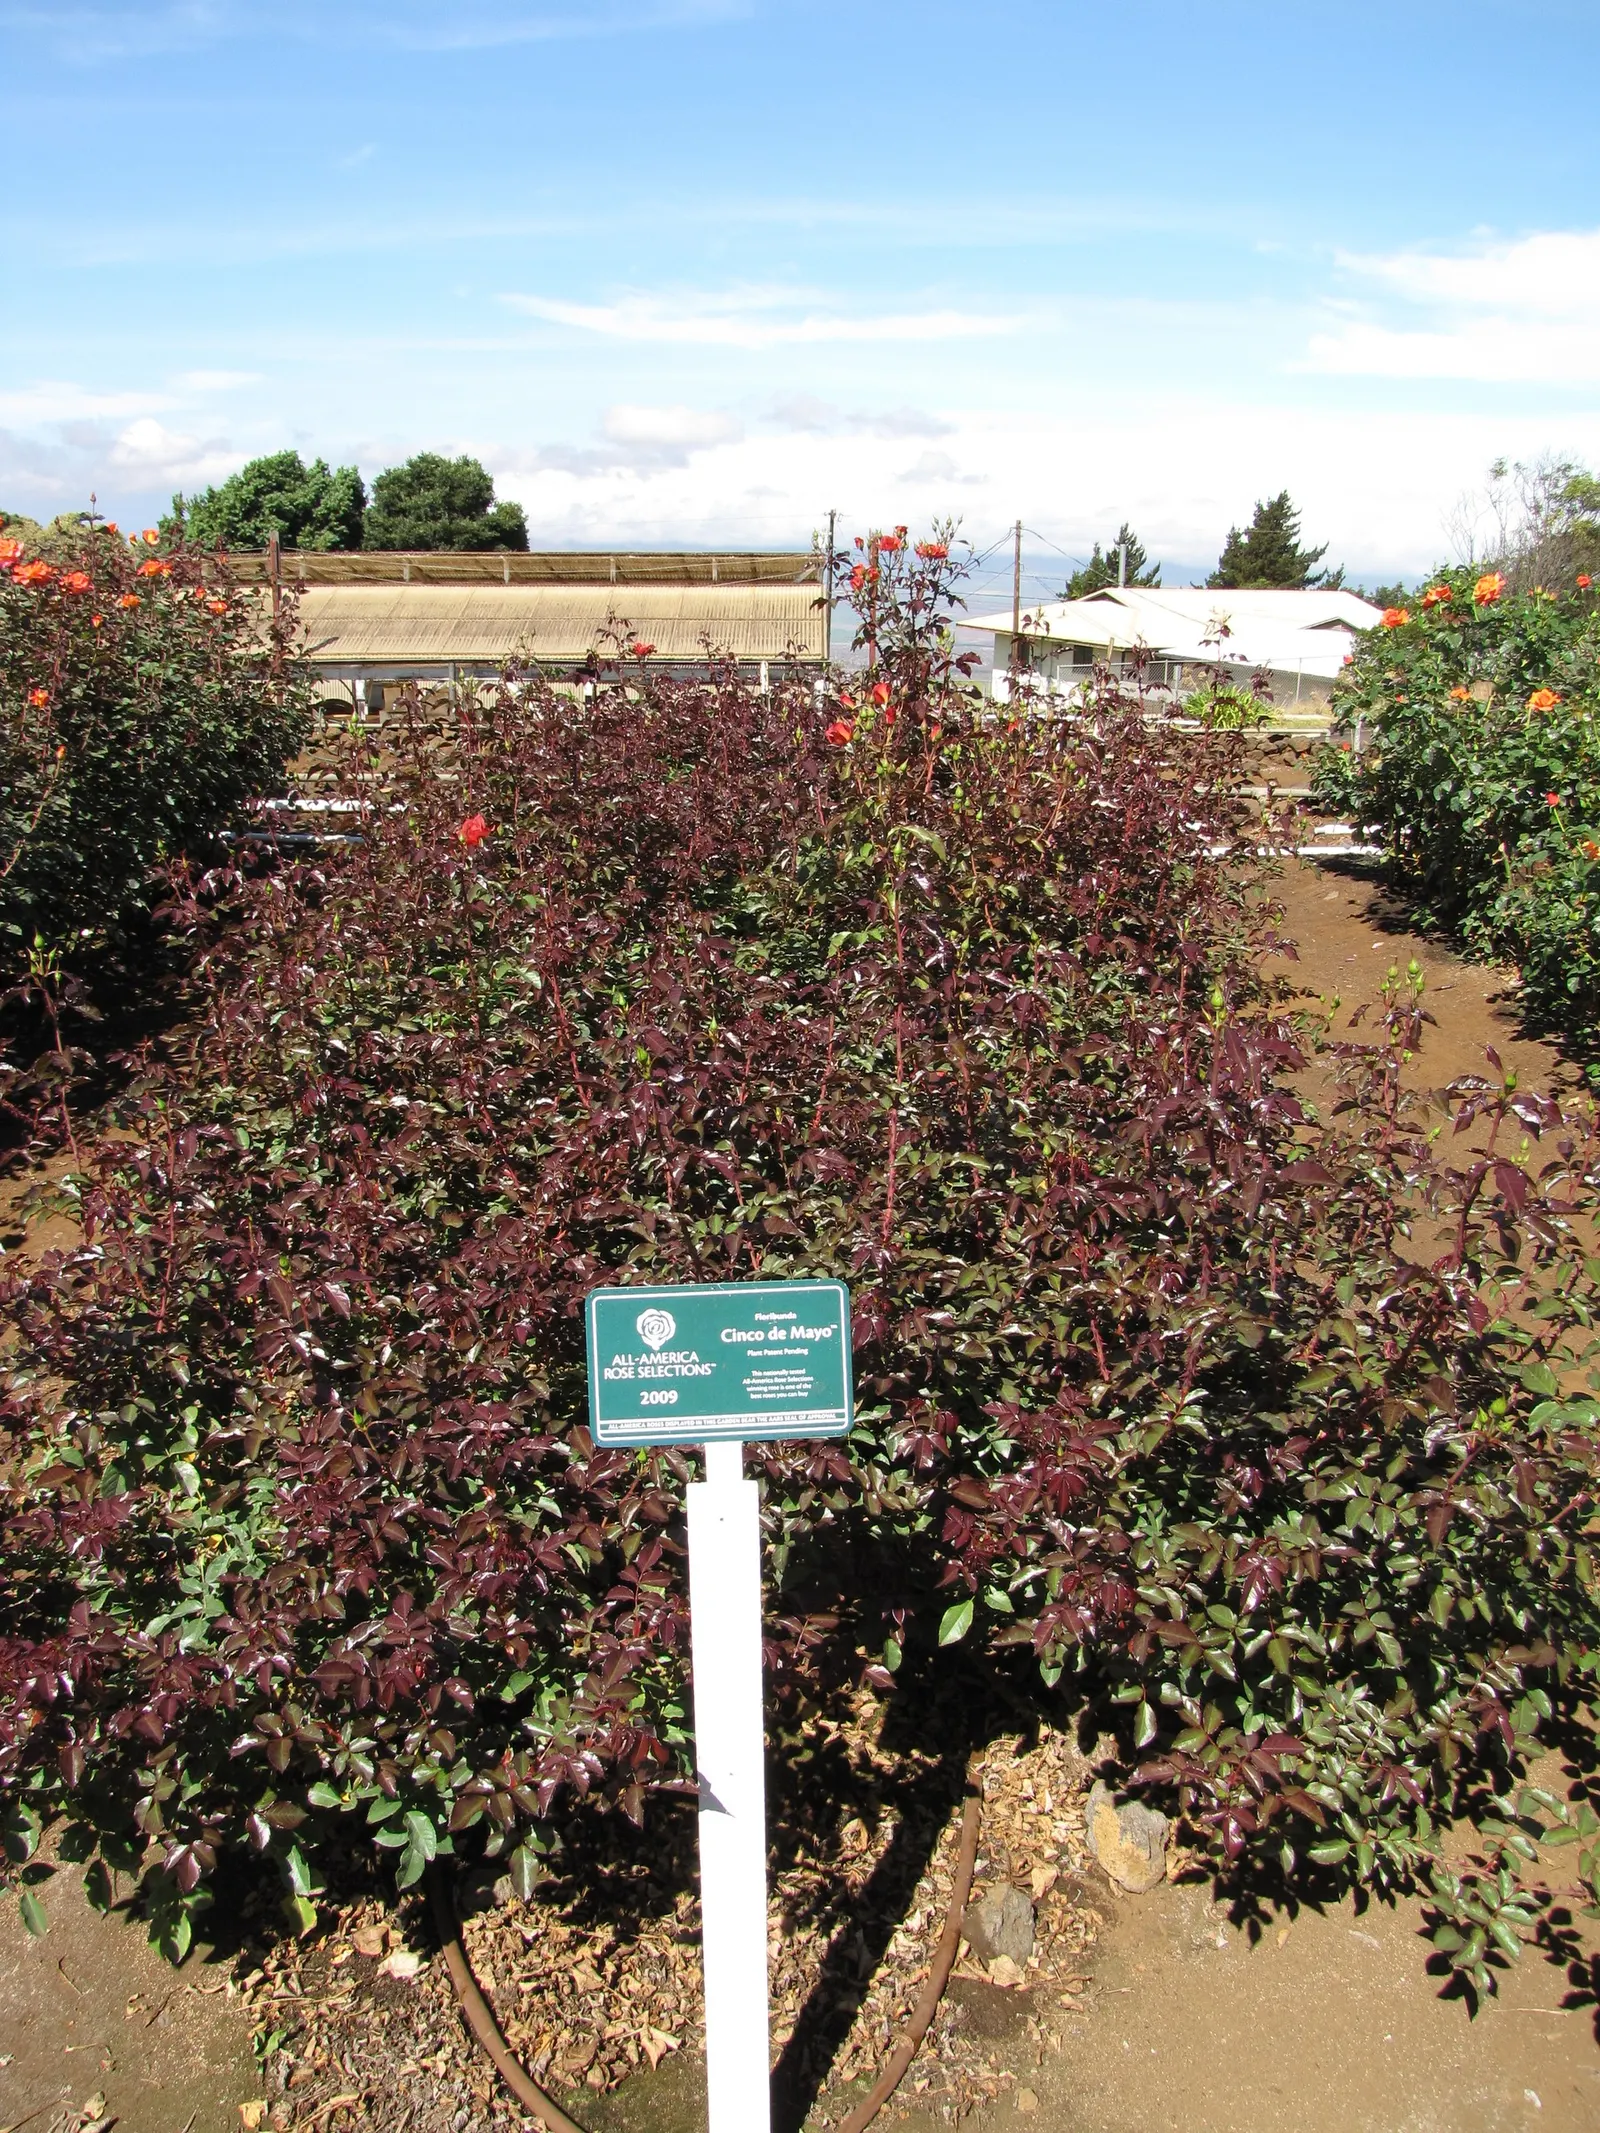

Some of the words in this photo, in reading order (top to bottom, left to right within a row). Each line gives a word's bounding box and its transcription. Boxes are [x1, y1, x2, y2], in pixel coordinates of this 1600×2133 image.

[755, 1311, 797, 1321] Floribunda
[720, 1328, 765, 1342] Cinco
[767, 1326, 787, 1340] de
[612, 1351, 700, 1366] ALL-AMERICA
[764, 1348, 784, 1356] Patent
[784, 1347, 808, 1356] Pending
[604, 1367, 635, 1380] ROSE
[639, 1390, 679, 1405] 2009
